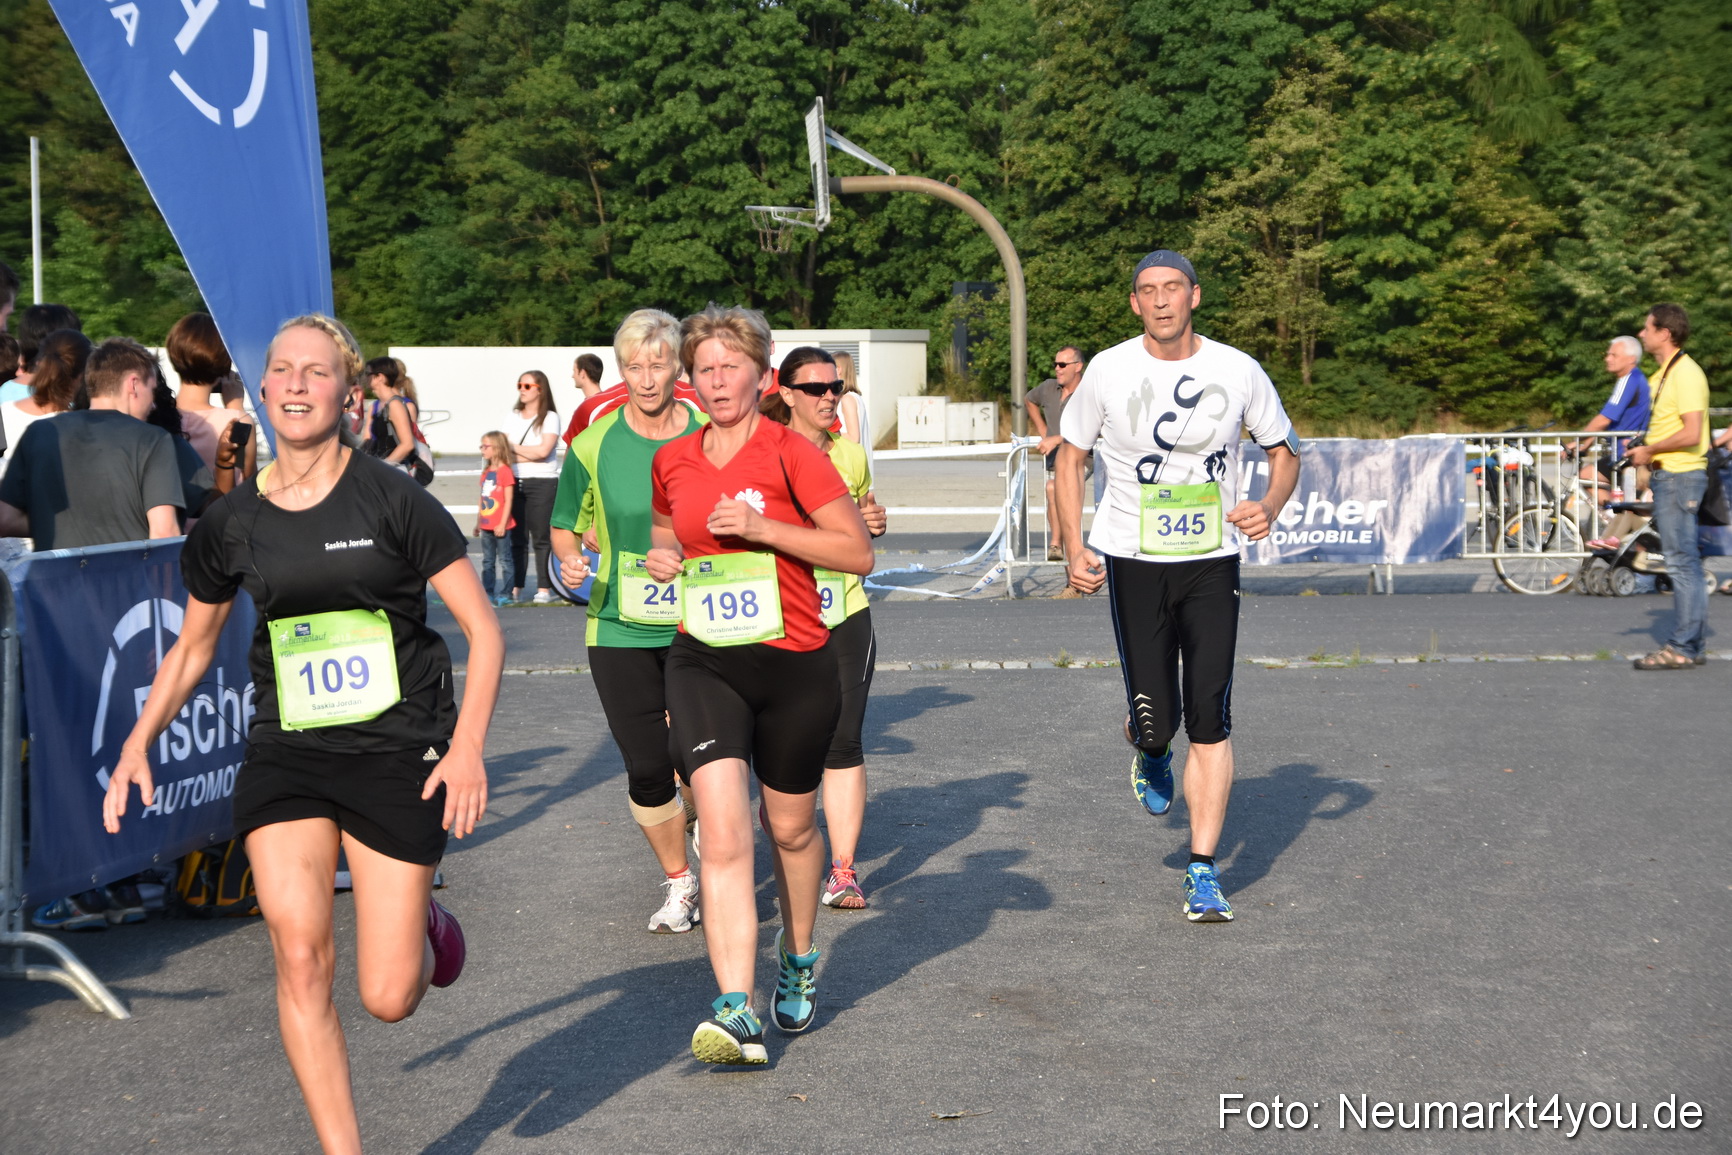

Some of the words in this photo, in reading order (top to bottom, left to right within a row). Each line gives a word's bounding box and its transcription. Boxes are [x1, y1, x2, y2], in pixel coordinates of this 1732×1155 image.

[1277, 491, 1388, 525] cher
[1157, 513, 1206, 537] 345
[324, 541, 347, 551] Saskia
[348, 538, 373, 548] Jordan
[643, 584, 677, 606] 24
[701, 589, 759, 621] 198
[706, 626, 732, 634] Christine
[733, 624, 758, 632] Mederer
[299, 655, 370, 695] 109
[311, 702, 336, 711] Saskia
[336, 698, 362, 708] Jordan
